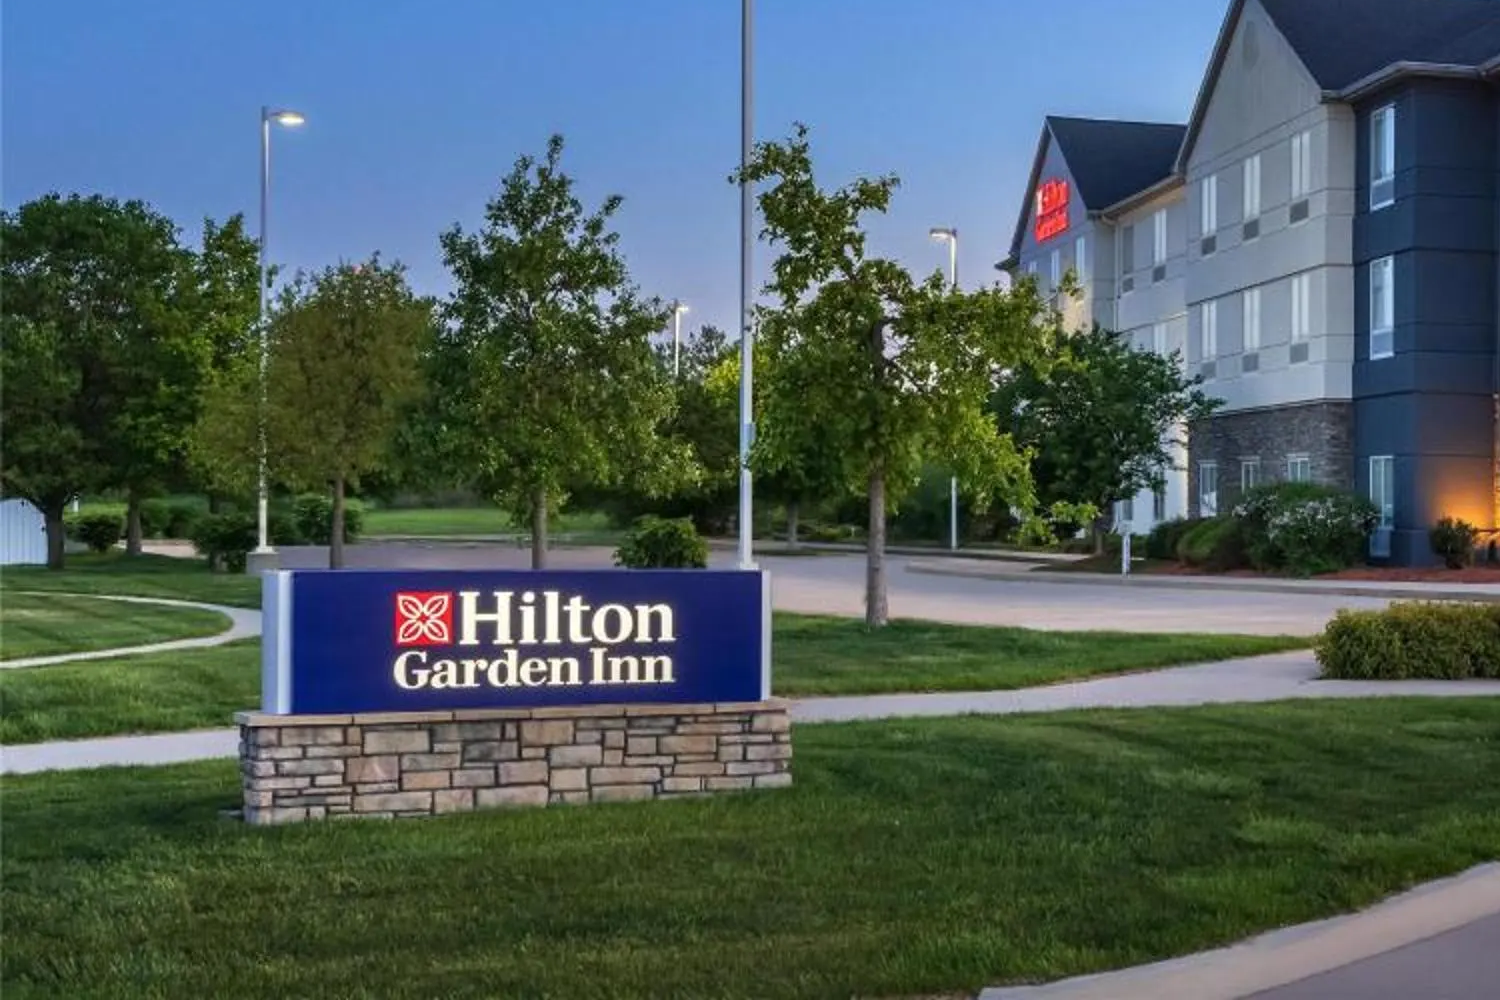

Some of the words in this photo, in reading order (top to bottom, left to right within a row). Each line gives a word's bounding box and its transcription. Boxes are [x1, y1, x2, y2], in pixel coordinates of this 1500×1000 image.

[458, 590, 677, 646] Hilton
[392, 649, 582, 689] Garden
[588, 647, 677, 685] Inn
